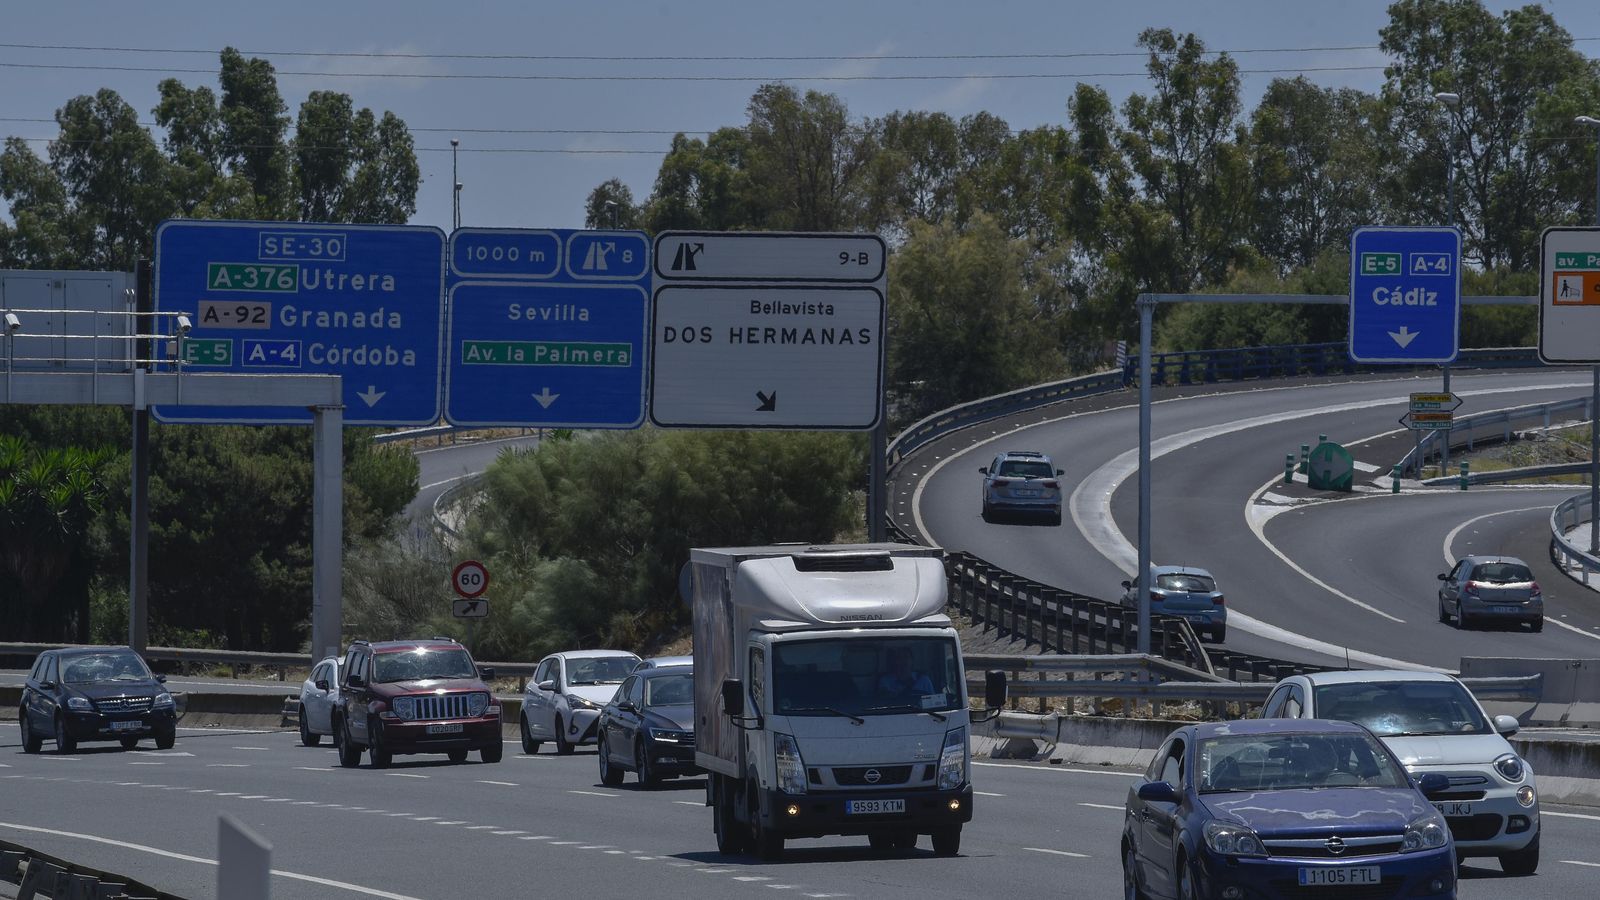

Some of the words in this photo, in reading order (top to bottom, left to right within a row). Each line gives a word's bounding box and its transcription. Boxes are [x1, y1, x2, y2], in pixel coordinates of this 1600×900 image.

[264, 238, 341, 258] SE-30
[467, 245, 519, 262] 1000
[529, 251, 545, 262] m
[622, 250, 633, 264] 8
[838, 251, 869, 266] 9-B
[1365, 257, 1397, 272] E-5
[1414, 257, 1448, 272] A-4
[1558, 257, 1579, 267] av.
[213, 266, 294, 290] A-376
[302, 268, 395, 291] Utrera
[1372, 285, 1438, 306] Cádiz
[507, 303, 590, 322] Sevilla
[750, 300, 835, 316] Bellavista
[203, 305, 266, 324] A-92
[279, 304, 402, 329] Granada
[663, 326, 713, 344] DOS
[729, 327, 871, 345] HERMANAS
[186, 343, 229, 363] E-5
[249, 343, 296, 363] A-4
[308, 342, 416, 367] Córdoba
[467, 345, 497, 362] Av.
[507, 346, 525, 363] la
[534, 346, 628, 365] Palmera
[461, 573, 481, 586] 60
[840, 614, 884, 622] NISSAN
[853, 801, 880, 813] 9593
[882, 801, 903, 812] KTM
[1449, 803, 1471, 815] JKJ
[1310, 869, 1346, 884] 1105
[1350, 868, 1377, 883] FTL
